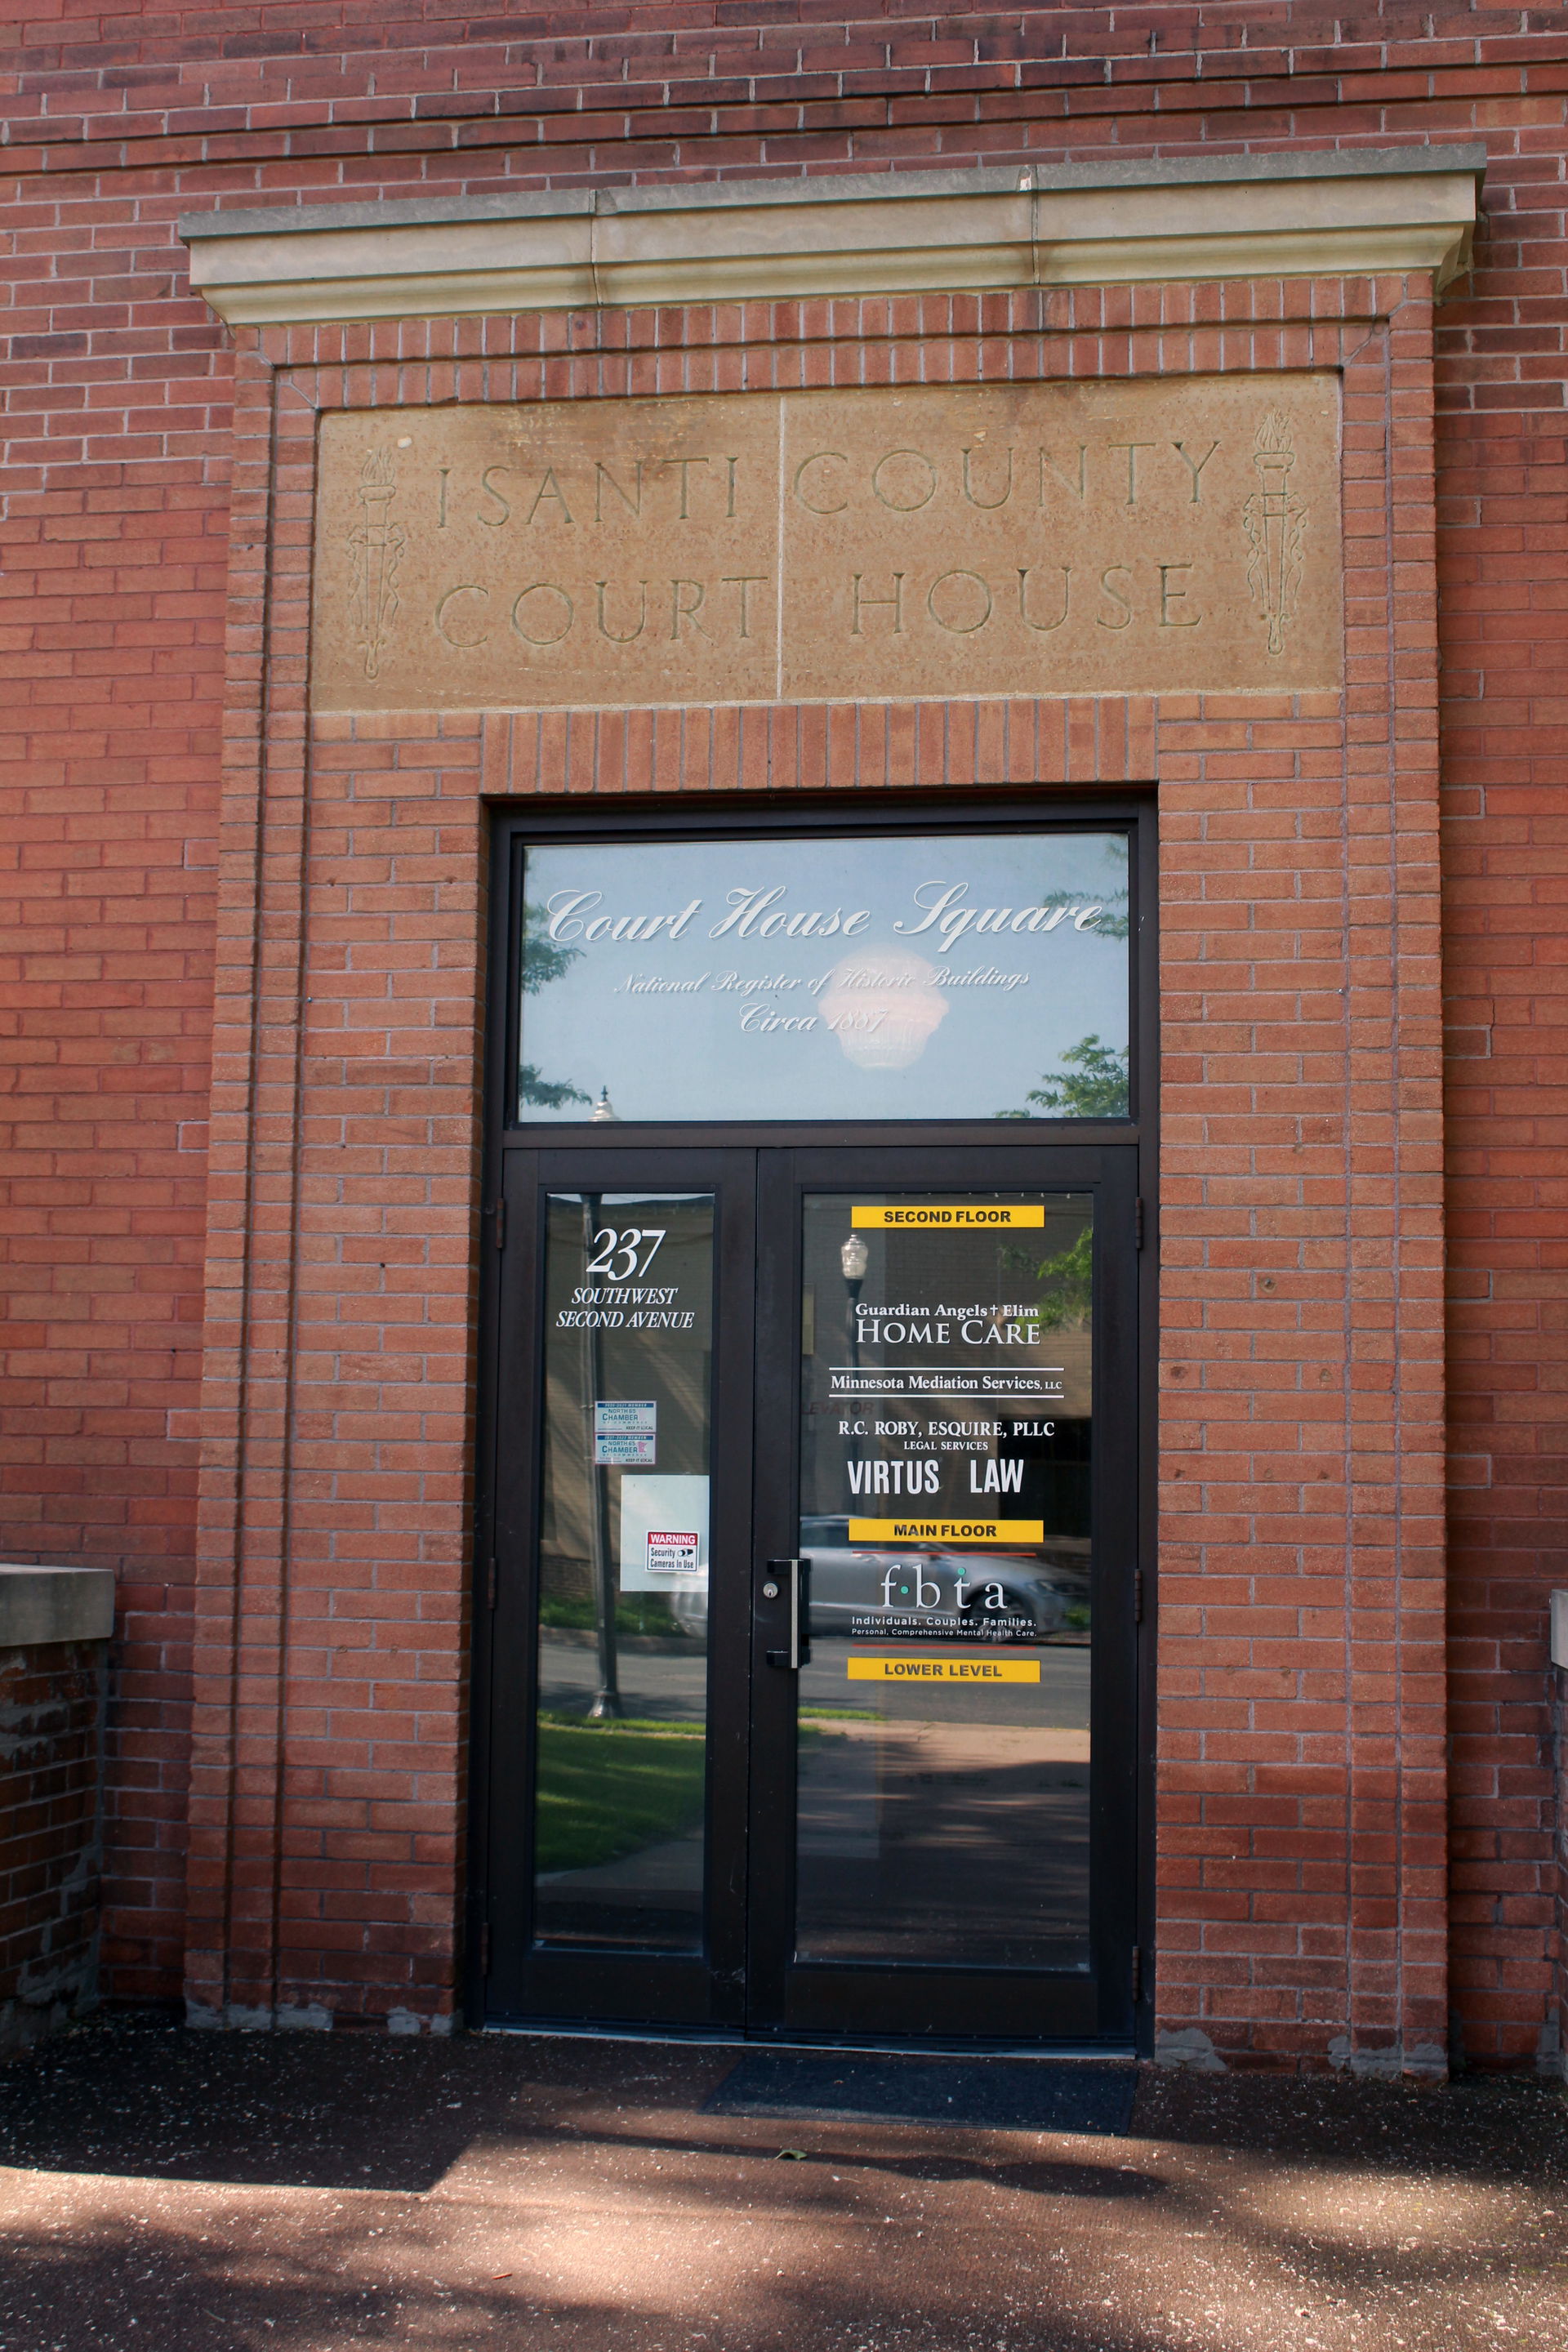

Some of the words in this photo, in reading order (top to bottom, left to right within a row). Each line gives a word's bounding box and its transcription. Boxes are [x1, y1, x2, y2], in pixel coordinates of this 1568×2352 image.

[437, 457, 739, 529] ISANTI
[793, 440, 1220, 514] COUNTY
[435, 576, 768, 648] COURT
[849, 564, 1203, 636] HOUSE
[546, 889, 704, 943] Court
[708, 885, 871, 940] House
[893, 881, 1103, 953] Square
[614, 971, 713, 994] National
[711, 969, 802, 996] Register
[808, 969, 835, 996] of
[837, 967, 915, 989] Historic
[923, 965, 1030, 991] Buildings
[738, 1003, 818, 1033] Circa
[826, 1008, 889, 1031] 1887
[884, 1210, 952, 1223] SECOND
[956, 1210, 1012, 1223] FLOOR
[586, 1228, 666, 1281] 237
[572, 1287, 678, 1305] SOUTHWEST
[556, 1311, 624, 1329] SECOND
[626, 1311, 694, 1330] AVENUE
[855, 1303, 930, 1316] Guardian
[934, 1303, 988, 1321] Angels
[1002, 1304, 1040, 1317] Elim
[856, 1319, 951, 1344] HOME
[961, 1320, 1040, 1345] CARE
[831, 1375, 904, 1389] Minnesota
[908, 1375, 978, 1390] Mediation
[982, 1375, 1043, 1391] Services,
[1045, 1381, 1062, 1390] LLC
[801, 1401, 875, 1414] LEVATOR
[838, 1420, 869, 1435] R.C.
[875, 1420, 923, 1437] ROBY,
[928, 1421, 1007, 1438] ESQUIRE,
[1013, 1422, 1055, 1437] PLLC
[903, 1441, 938, 1450] LEGAL
[941, 1441, 989, 1451] SERVICES
[848, 1459, 940, 1494] VIRTUS
[969, 1459, 1024, 1494] LAW
[650, 1534, 696, 1544] WARNING
[893, 1524, 937, 1537] MAIN
[941, 1524, 997, 1537] FLOOR
[651, 1547, 675, 1558] Security
[650, 1558, 675, 1568] Cameras
[677, 1559, 682, 1568] In
[684, 1559, 693, 1569] Use
[852, 1616, 921, 1625] Individuals.
[926, 1617, 978, 1628] Couples.
[982, 1617, 1037, 1627] Families.
[852, 1628, 889, 1636] Personal,
[891, 1628, 954, 1637] Comprehensive
[986, 1629, 1013, 1637] Health
[1015, 1629, 1037, 1637] Care.
[884, 1663, 943, 1676] LOWER
[949, 1664, 1003, 1677] LEVEL
